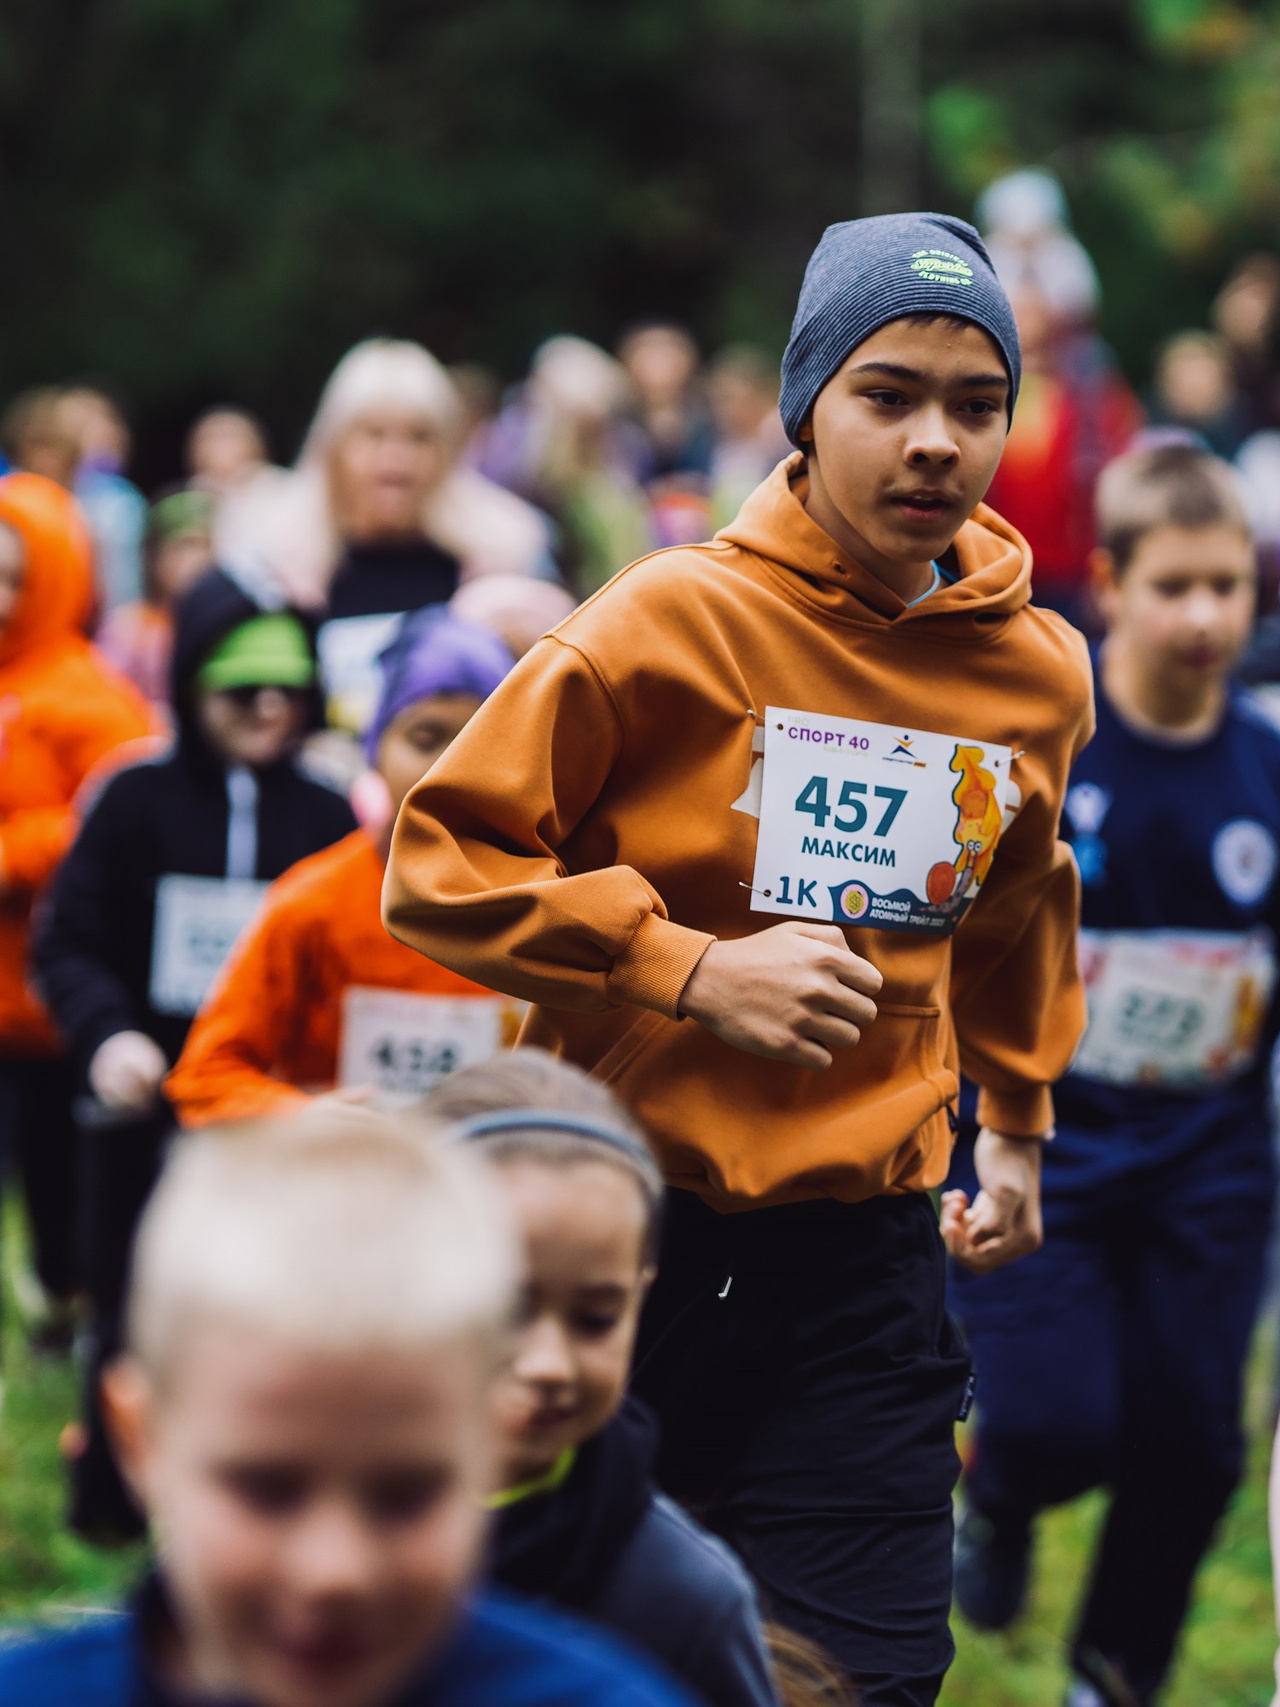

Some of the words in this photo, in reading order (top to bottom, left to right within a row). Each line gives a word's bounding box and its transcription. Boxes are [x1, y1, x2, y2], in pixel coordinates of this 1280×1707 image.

[788, 727, 845, 748] СПОРТ
[848, 737, 870, 752] 40
[795, 776, 908, 838] 457
[802, 837, 896, 868] МАКСИМ
